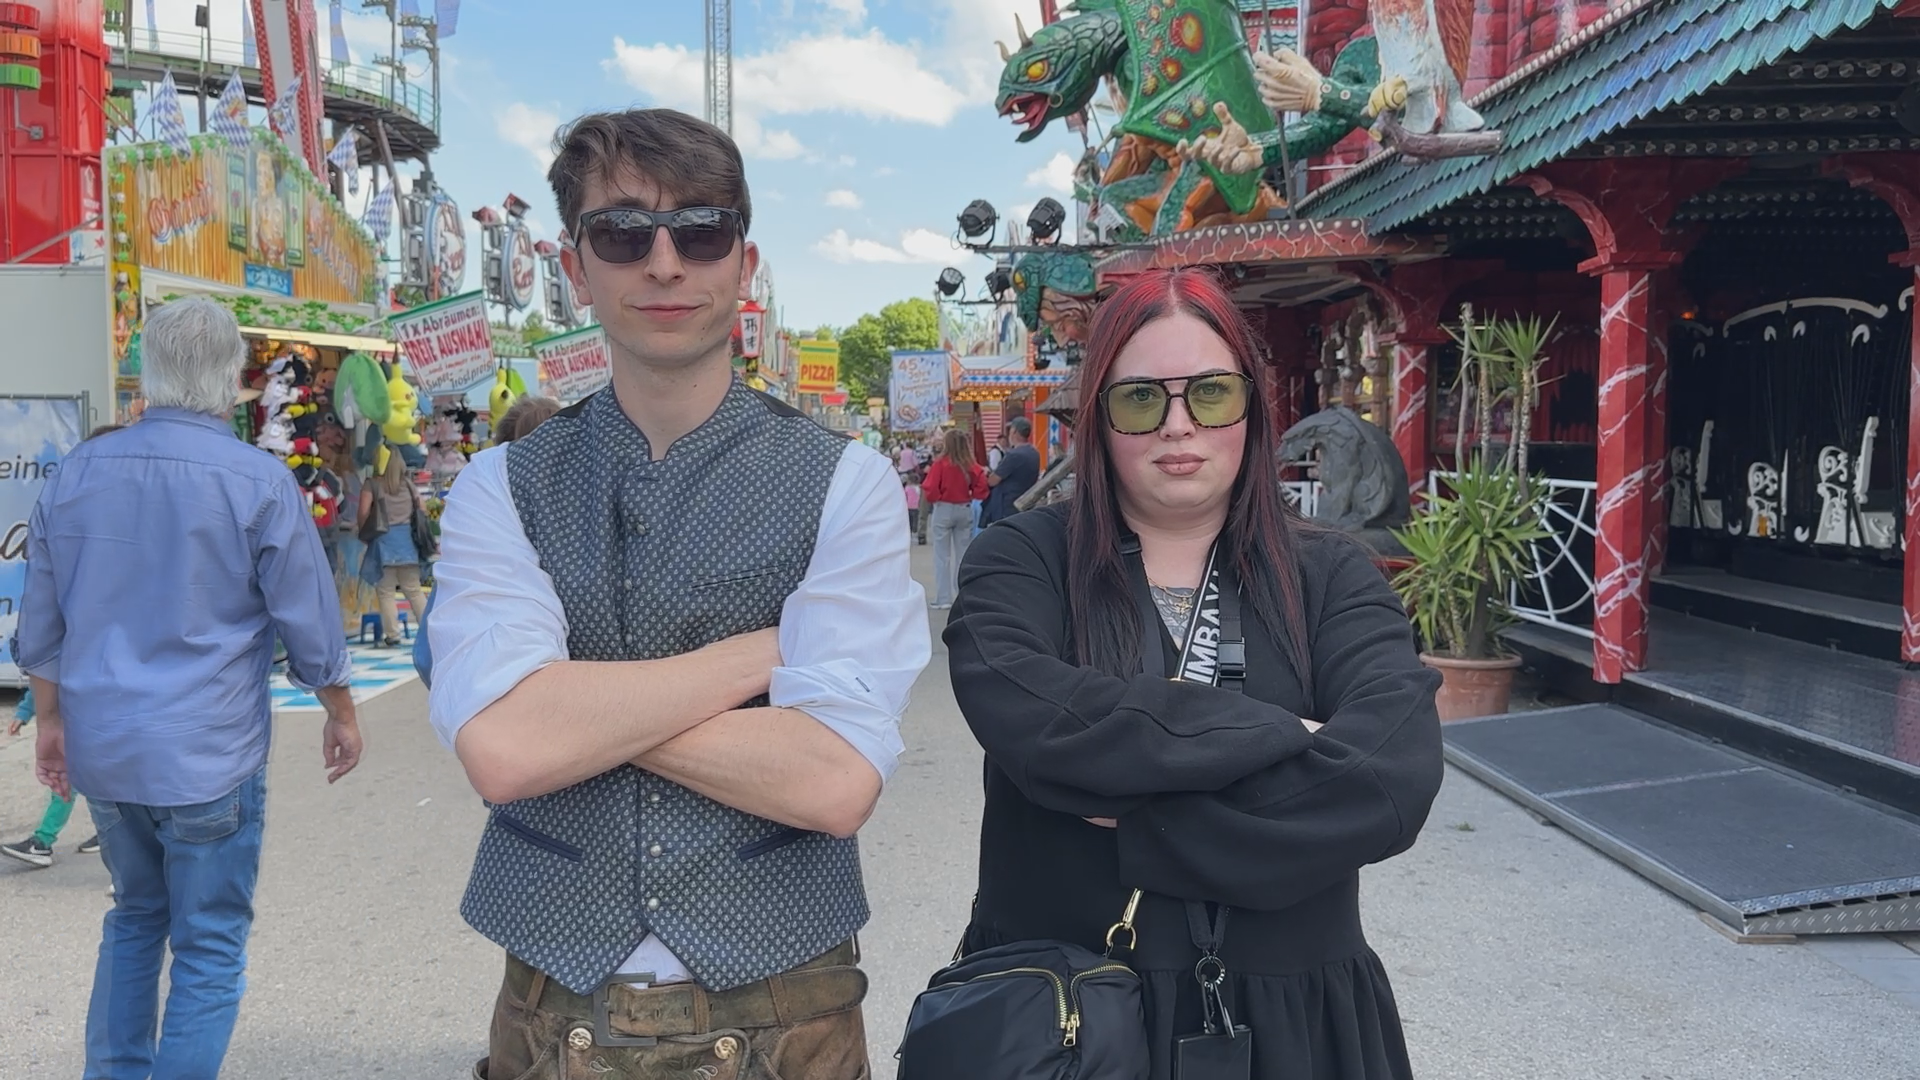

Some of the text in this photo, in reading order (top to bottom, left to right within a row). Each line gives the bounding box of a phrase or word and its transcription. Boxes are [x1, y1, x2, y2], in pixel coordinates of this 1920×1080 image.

[423, 305, 480, 334] Abräumen:
[437, 318, 490, 359] AUSWAHL
[800, 363, 835, 382] PIZZA
